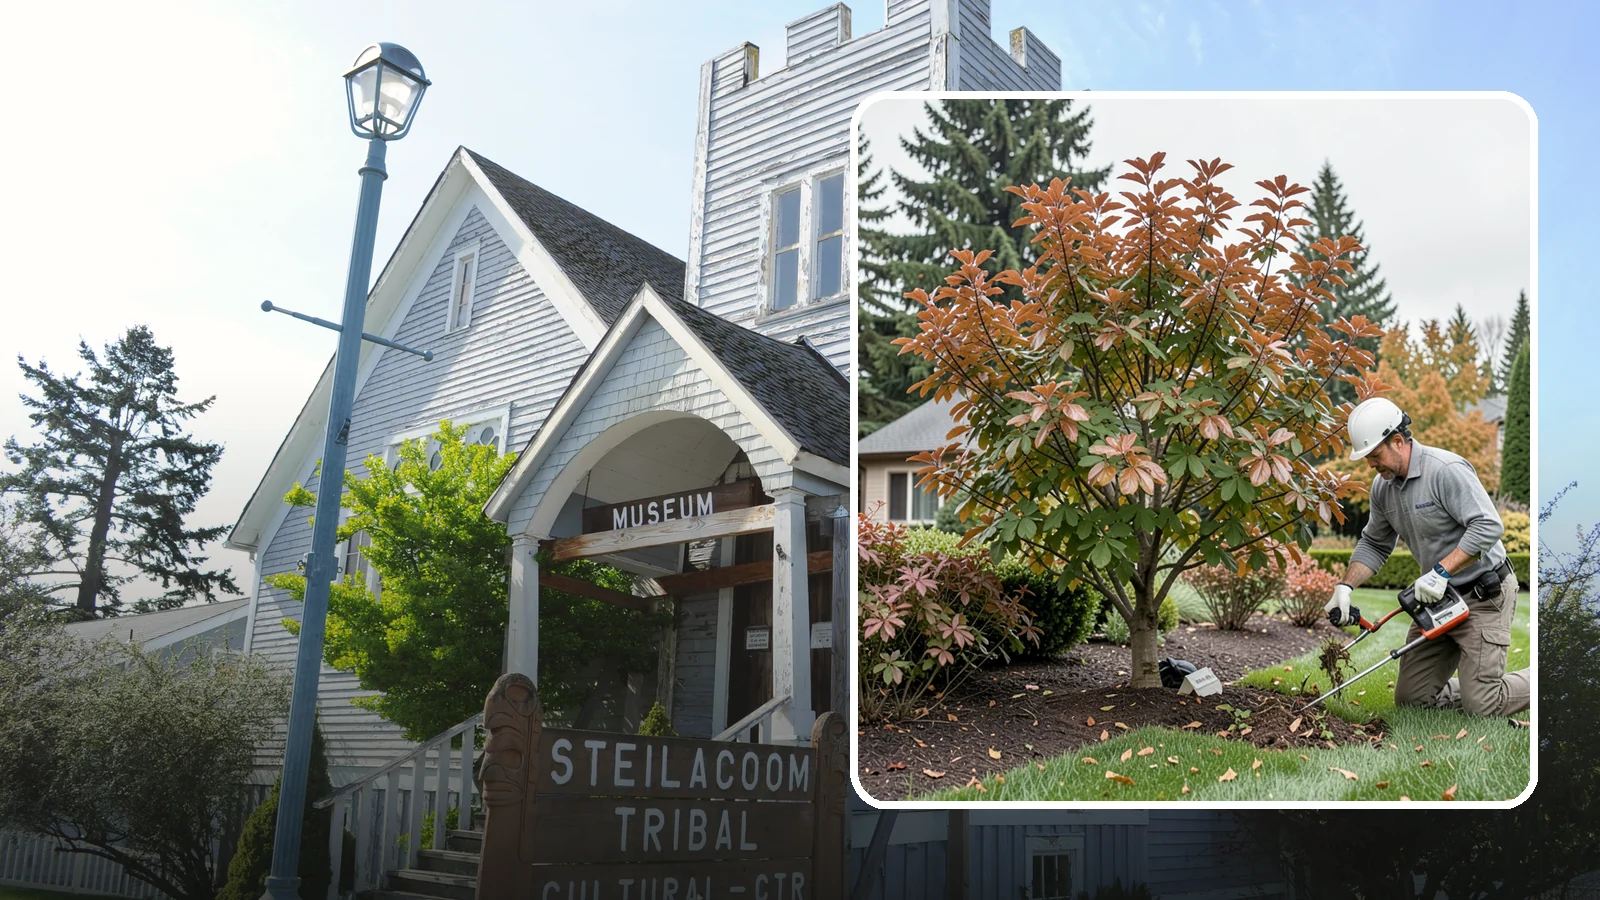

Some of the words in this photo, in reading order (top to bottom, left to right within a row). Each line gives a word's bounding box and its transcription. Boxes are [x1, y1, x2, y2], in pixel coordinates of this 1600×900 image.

[613, 491, 714, 531] MUSEUM
[550, 738, 809, 793] STEILACOOM
[615, 806, 757, 851] TRIBAL
